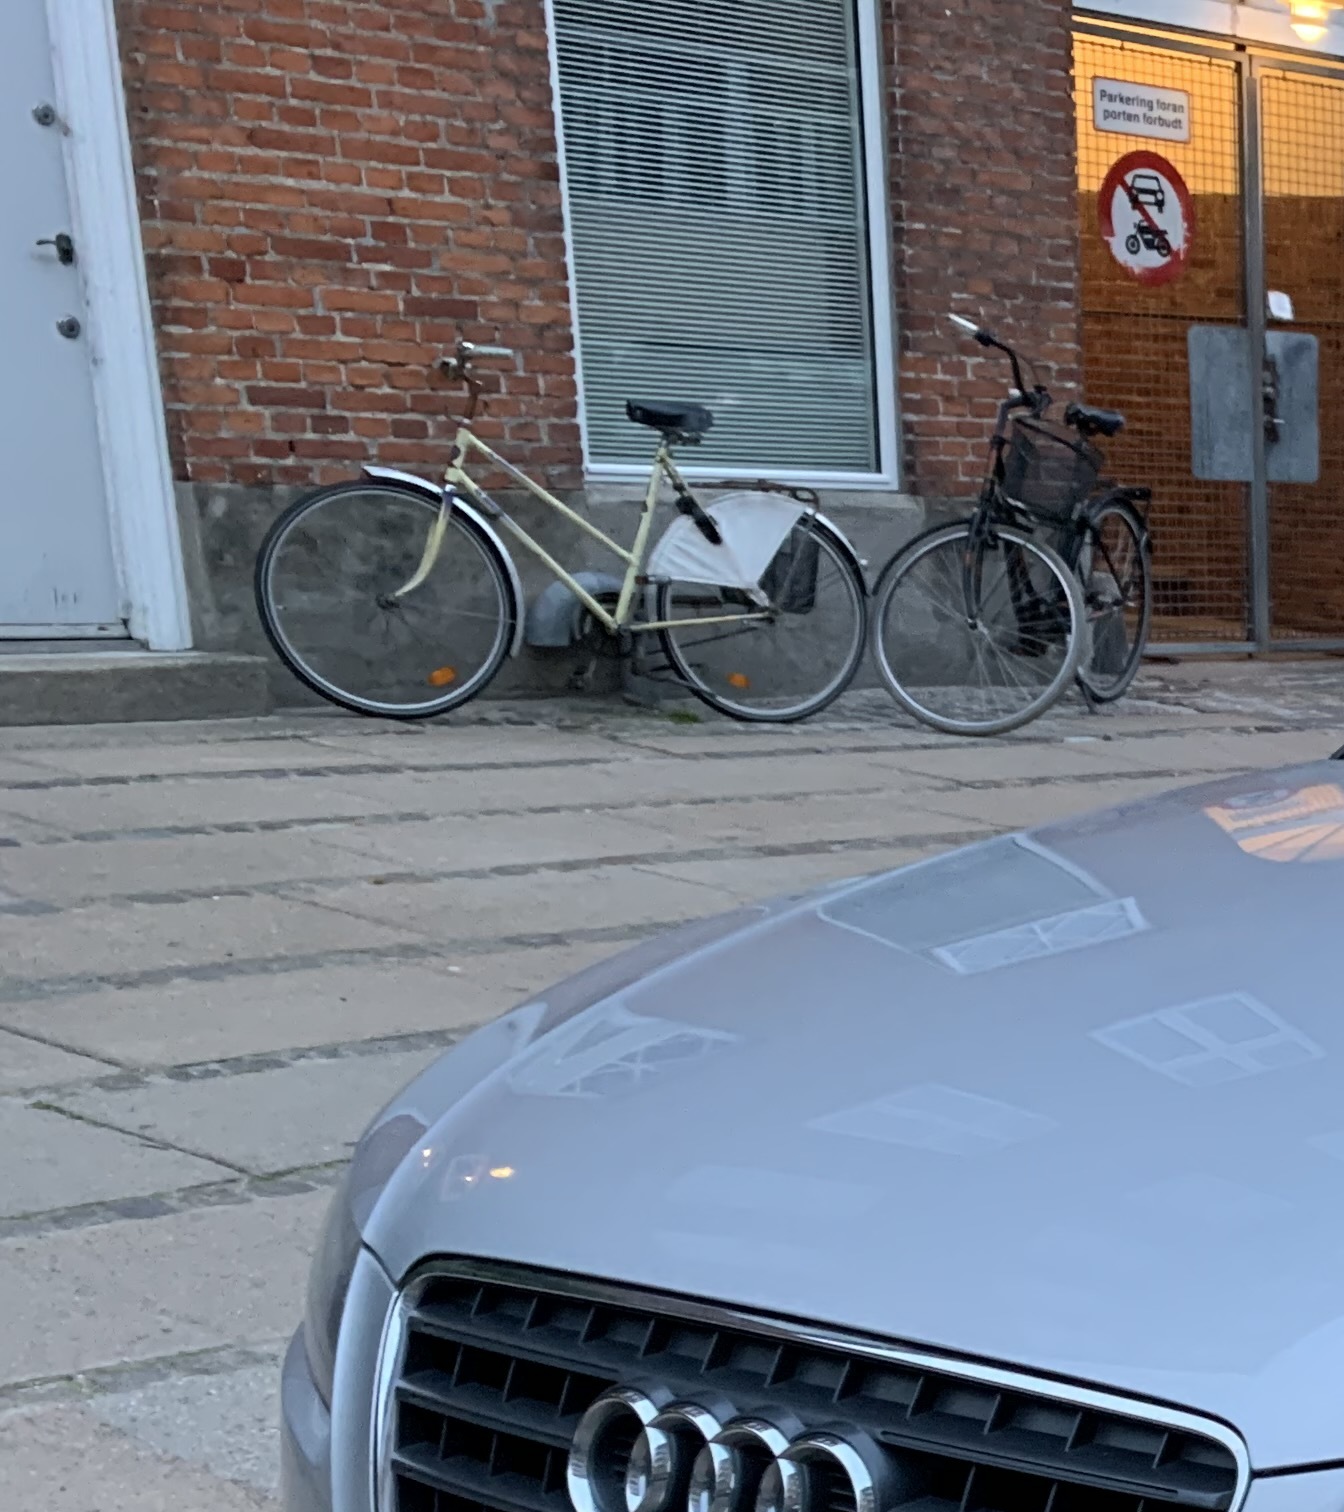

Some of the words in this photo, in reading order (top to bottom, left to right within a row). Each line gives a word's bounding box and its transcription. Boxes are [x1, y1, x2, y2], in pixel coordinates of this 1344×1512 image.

[1099, 89, 1154, 111] Parkering
[1156, 98, 1185, 114] foran
[1103, 109, 1140, 123] porten
[1142, 112, 1183, 130] forbudt
